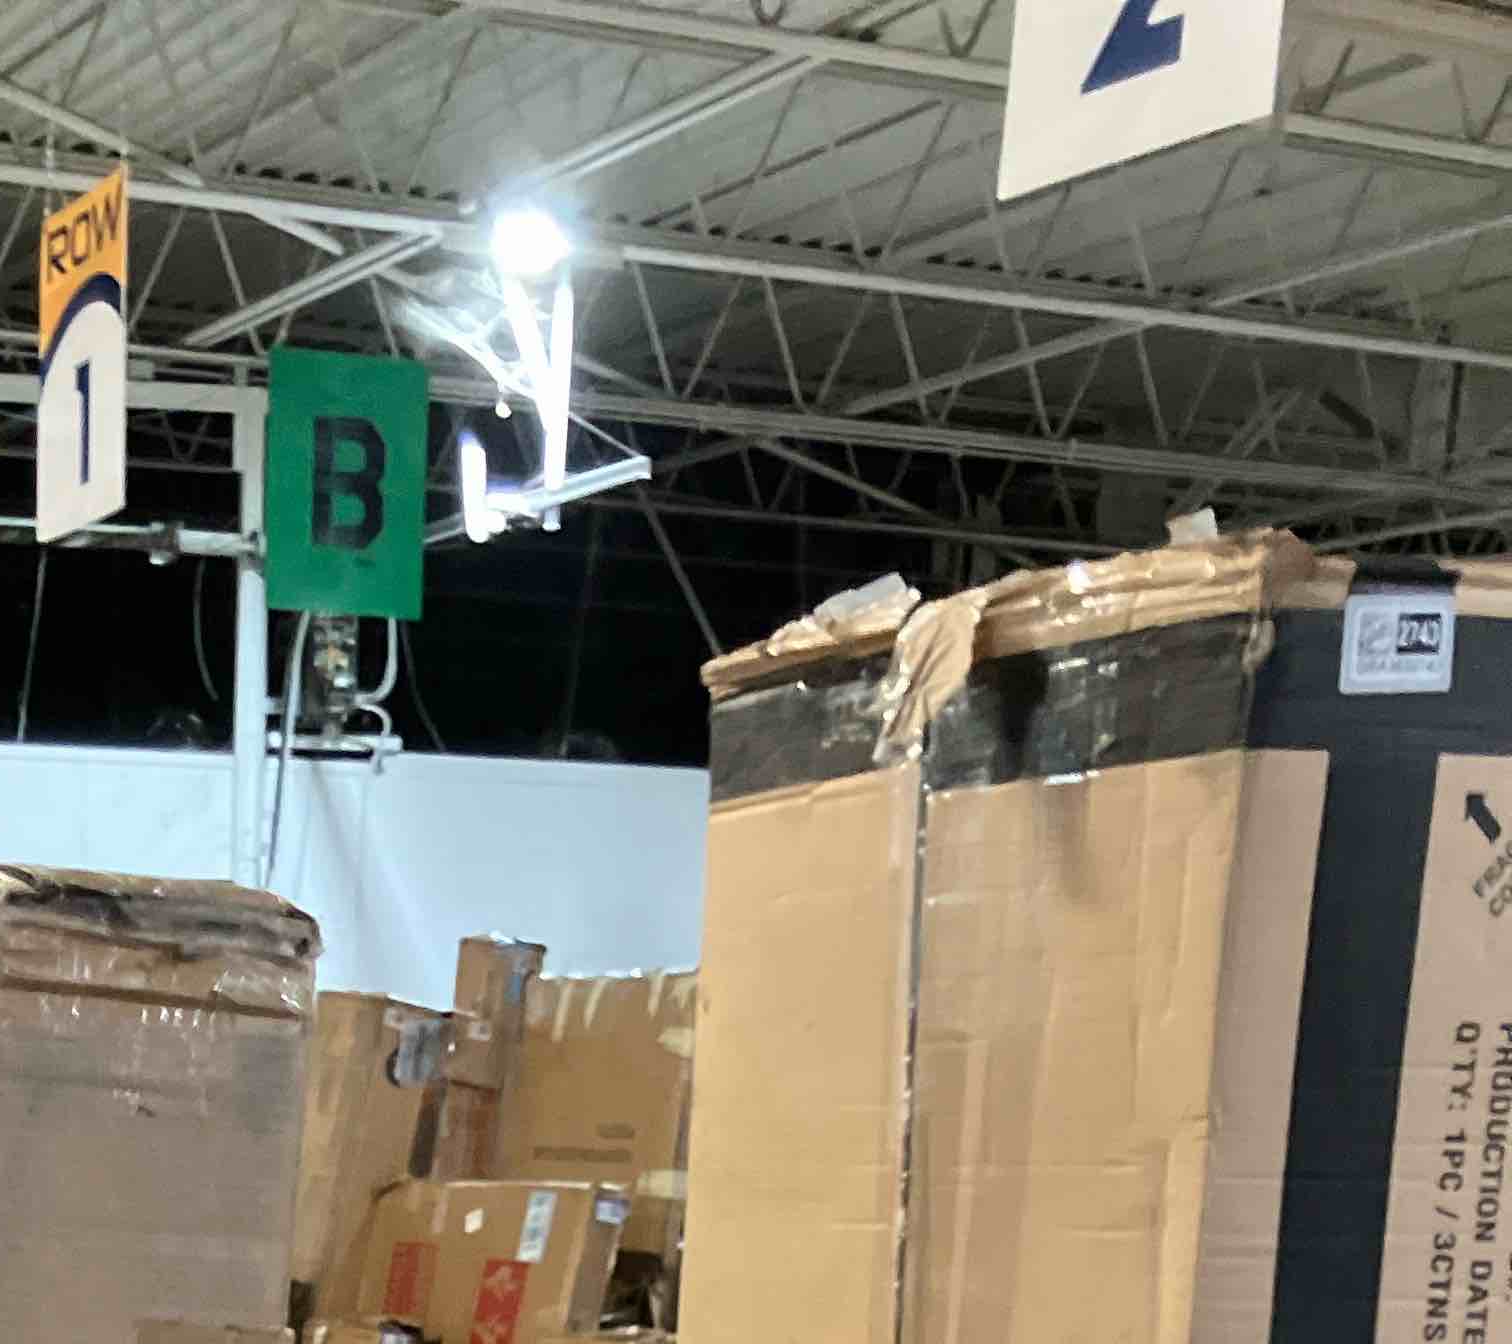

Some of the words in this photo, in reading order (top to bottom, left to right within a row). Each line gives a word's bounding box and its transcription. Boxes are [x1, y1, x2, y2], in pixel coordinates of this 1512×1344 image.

[45, 196, 122, 286] ROW
[74, 360, 91, 485] 1
[312, 415, 386, 550] B
[1438, 1128, 1467, 1194] 1PC
